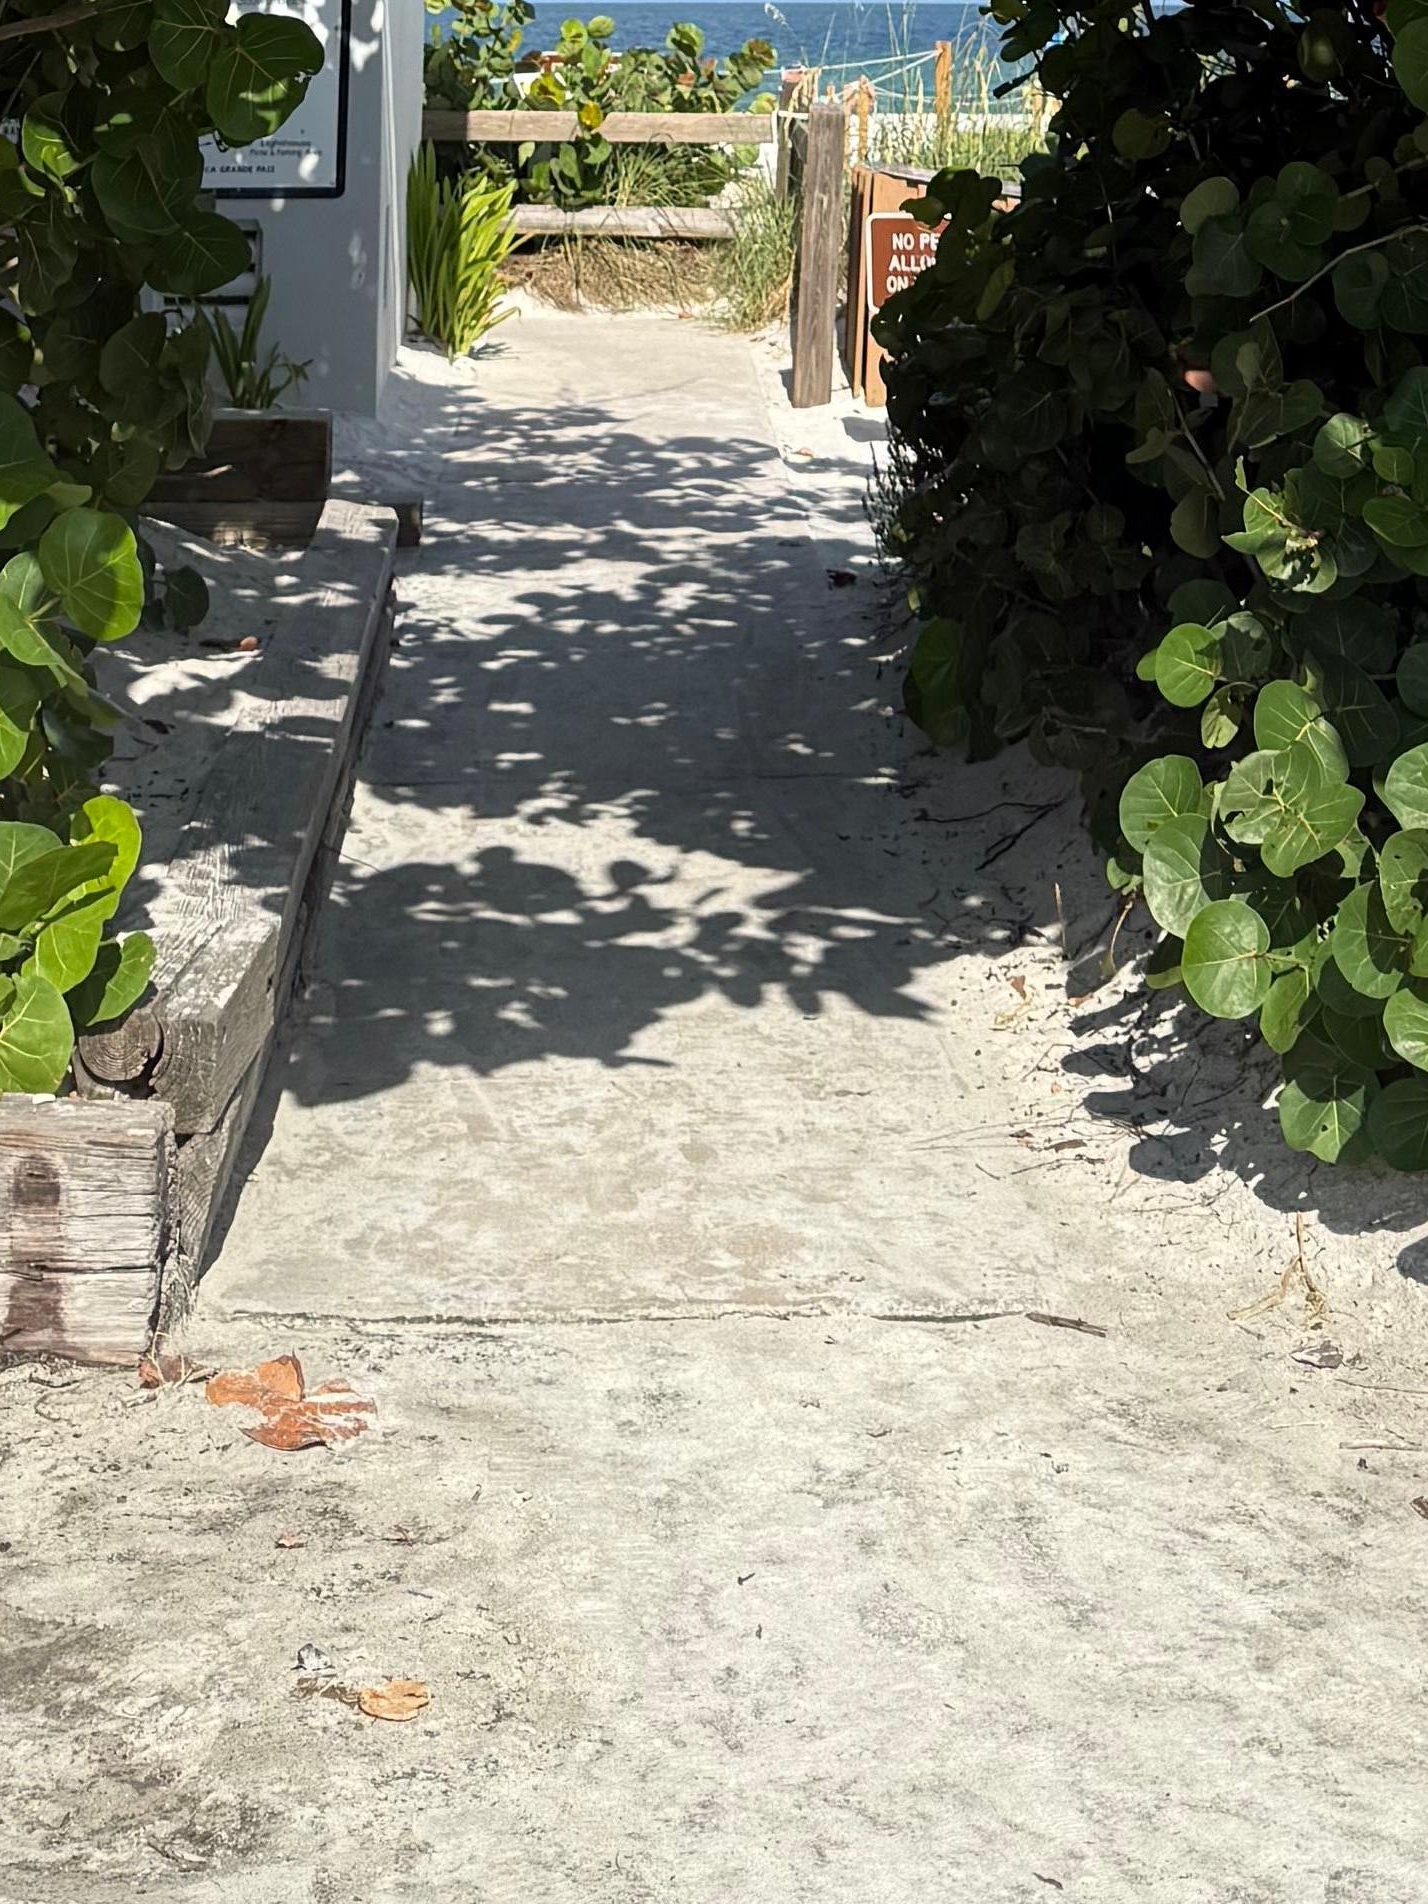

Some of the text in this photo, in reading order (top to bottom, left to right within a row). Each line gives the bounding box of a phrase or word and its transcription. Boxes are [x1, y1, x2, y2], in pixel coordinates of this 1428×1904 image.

[892, 233, 941, 251] NO PE
[888, 254, 936, 273] ALLO
